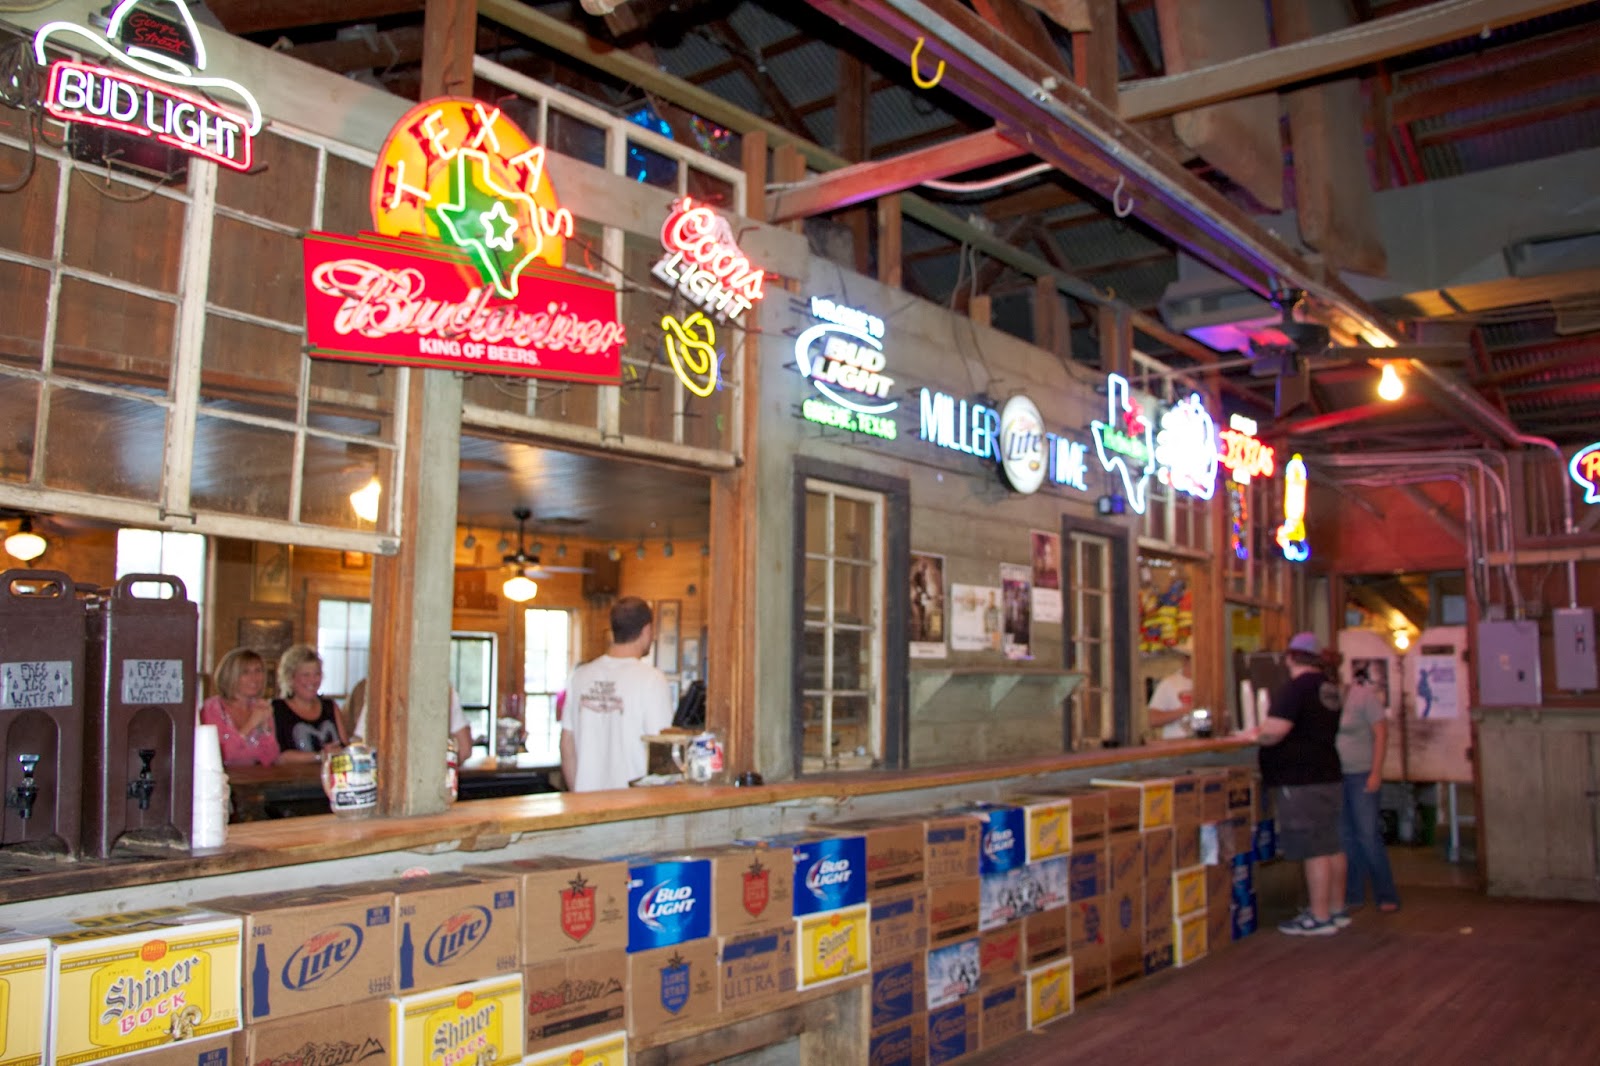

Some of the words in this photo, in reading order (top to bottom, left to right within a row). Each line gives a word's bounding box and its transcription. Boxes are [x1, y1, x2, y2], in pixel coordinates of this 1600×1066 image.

[58, 69, 138, 122] BUD
[146, 91, 238, 159] LIGHT
[380, 104, 573, 238] TEXAS
[662, 197, 764, 301] Coors
[652, 252, 752, 319] LIGHT
[312, 259, 625, 353] Budweiser
[419, 336, 461, 357] KING
[462, 341, 486, 359] OF
[824, 336, 886, 373] BUD
[811, 356, 894, 398] LIGHT
[920, 387, 1001, 463] MILLER
[1045, 432, 1088, 492] TIME
[1008, 430, 1043, 460] Lite
[21, 663, 49, 679] FREE
[23, 677, 47, 692] ICE
[138, 661, 166, 676] FREE
[142, 676, 161, 688] ICE
[11, 691, 56, 708] WATER
[130, 689, 170, 702] WATER
[814, 869, 852, 888] LIGHT
[820, 858, 849, 875] BUD
[648, 898, 695, 919] LIGHT
[655, 886, 692, 903] BUD
[436, 919, 483, 964] Lite
[297, 937, 352, 988] Lite
[102, 957, 199, 1025] Shiner
[724, 974, 776, 1001] ULTRA
[120, 993, 187, 1036] BOCK
[431, 1004, 495, 1061] Shiner
[444, 1033, 487, 1066] BOCK
